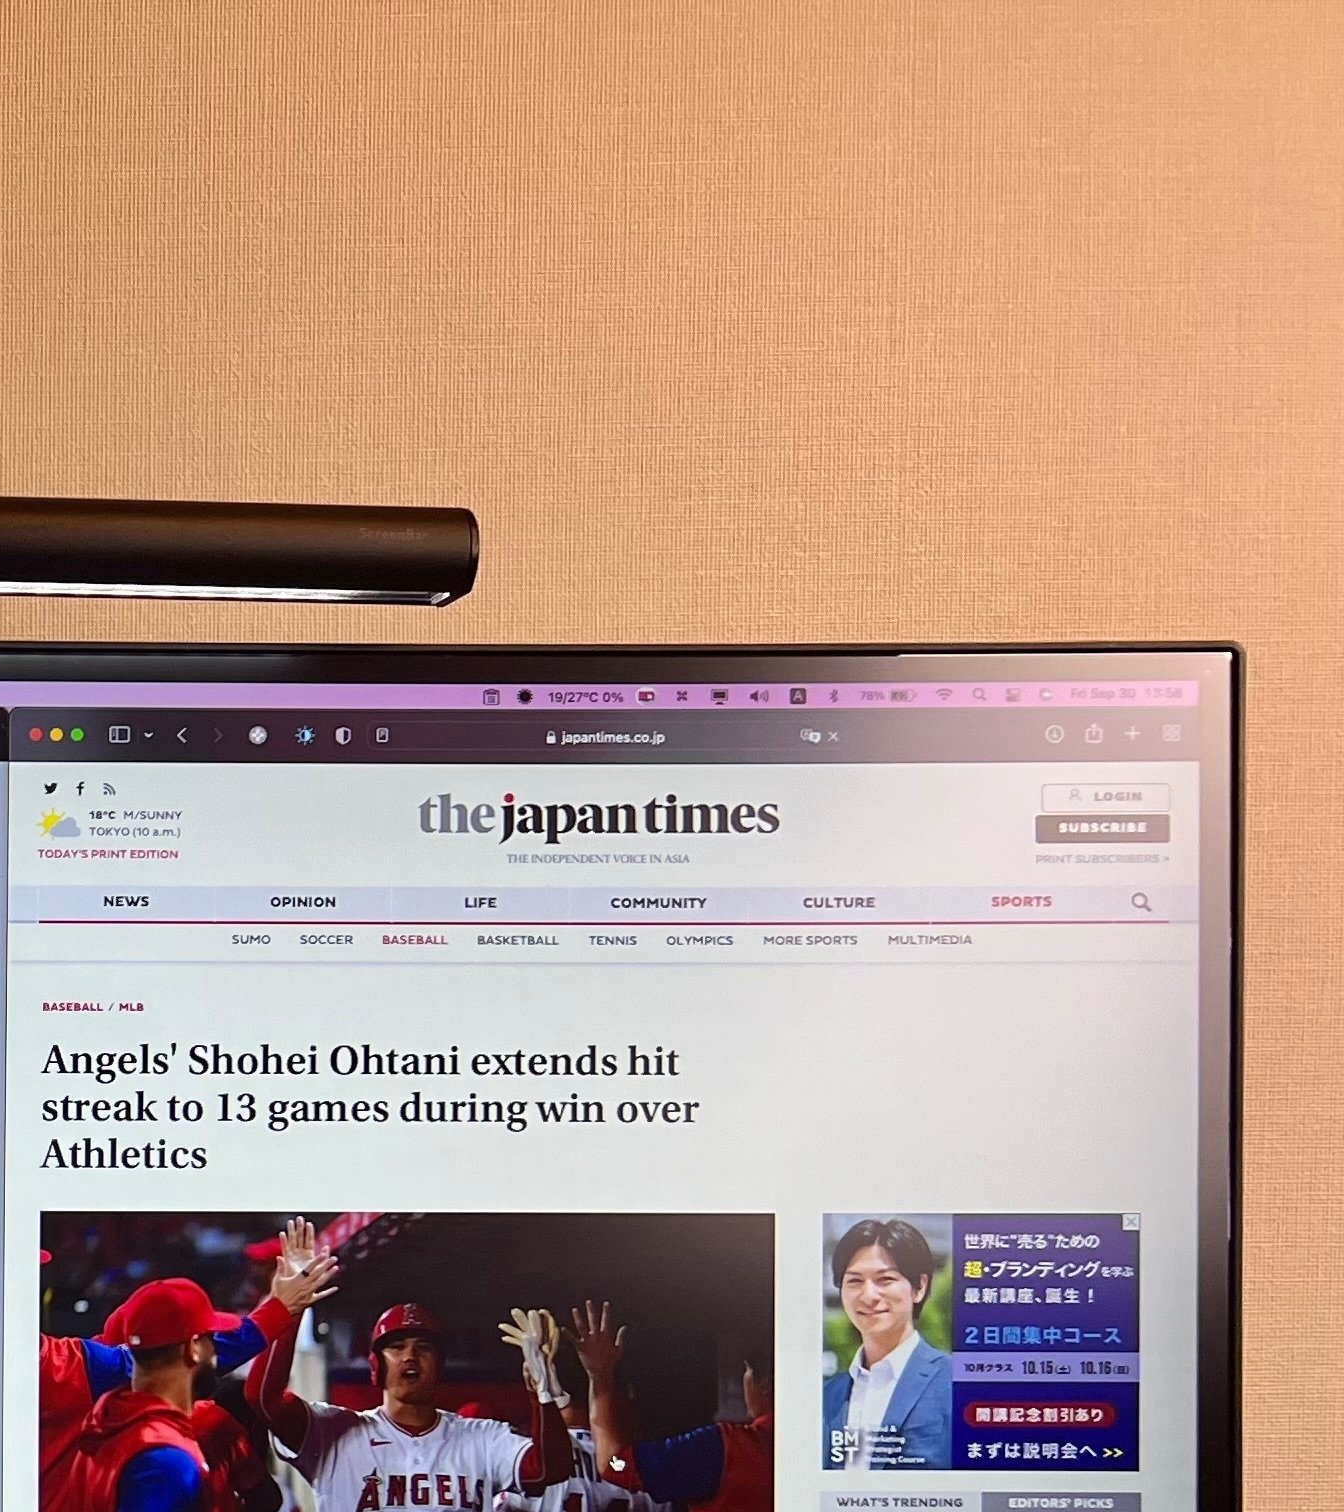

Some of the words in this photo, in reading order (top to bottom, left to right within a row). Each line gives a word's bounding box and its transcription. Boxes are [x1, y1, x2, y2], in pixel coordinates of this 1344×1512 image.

[560, 731, 665, 745] japantimes.co.jp
[1094, 792, 1142, 801] LOGIN
[418, 793, 496, 835] the
[498, 791, 638, 845] japan
[643, 793, 780, 835] times
[1059, 822, 1146, 832] SUBSCRIBE
[507, 854, 528, 863] THE
[531, 854, 610, 863] INDEPENDENT
[613, 854, 647, 863] VOICE
[650, 855, 661, 863] IN
[665, 854, 690, 863] ASIA
[104, 896, 149, 906] NEWS
[271, 897, 335, 907] OPINION
[465, 898, 496, 908] LIFE
[611, 898, 706, 908] COMMUNITY
[803, 897, 875, 908] CULTURE
[992, 896, 1052, 907] SPORTS
[232, 935, 271, 944] SUMO
[300, 935, 353, 944] SOCCER
[383, 935, 448, 944] BASEBALL
[478, 936, 559, 945] BASKETBALL
[589, 936, 637, 945] TENNIS
[667, 936, 733, 945] OLYMPICS
[764, 936, 802, 945] MORE
[806, 936, 857, 945] SPORTS
[888, 935, 972, 944] MULTIMEDIA
[41, 1043, 176, 1084] Angels'
[189, 1044, 319, 1075] Shohei
[331, 1044, 460, 1075] Ohtani
[472, 1045, 617, 1076] extends
[628, 1045, 679, 1075] hit
[43, 1091, 158, 1121] streak
[167, 1096, 203, 1121] to
[218, 1094, 256, 1122] 13
[268, 1101, 389, 1131] games
[400, 1092, 527, 1132] during
[535, 1093, 606, 1122] win
[617, 1102, 699, 1123] over
[40, 1138, 207, 1169] Athletics
[837, 1498, 889, 1507] WHAT'S
[893, 1498, 963, 1507] TRENDING
